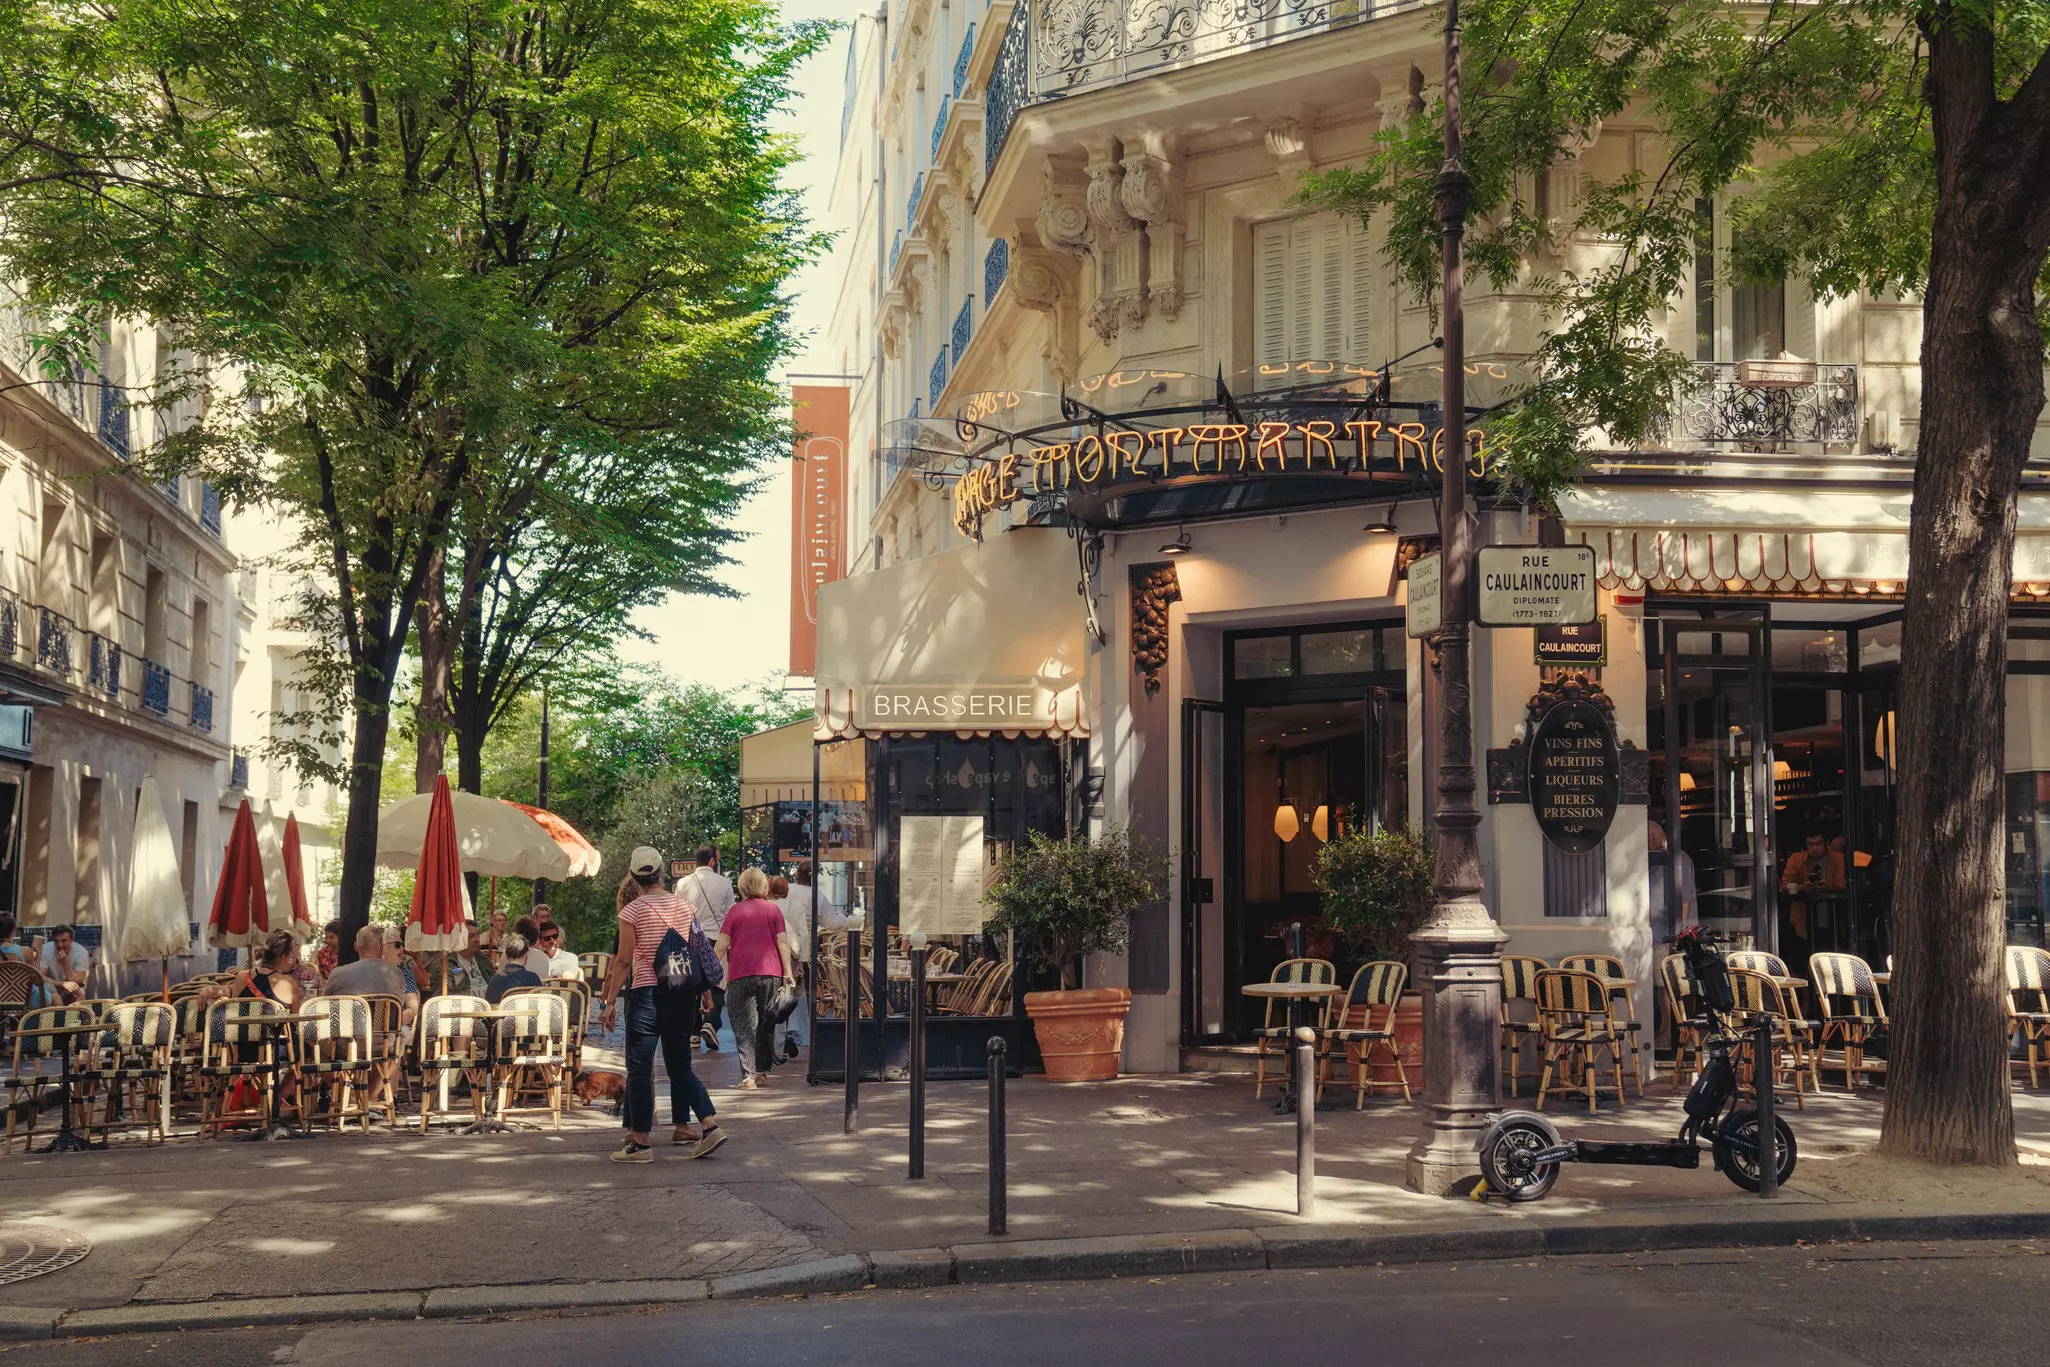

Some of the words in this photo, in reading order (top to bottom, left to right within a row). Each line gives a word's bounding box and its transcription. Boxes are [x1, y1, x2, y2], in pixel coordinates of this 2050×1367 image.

[1522, 556, 1550, 567] RUE
[1486, 573, 1586, 591] CAULAINCOURT
[1513, 596, 1560, 605] DIPLOMATE
[1562, 626, 1579, 635] RUE
[1539, 642, 1602, 653] CAULAINCOURT
[874, 694, 1032, 716] BRASSERIE
[1544, 738, 1572, 749] VINS
[1576, 738, 1603, 749] FINS
[1544, 756, 1604, 767] APERITIFS
[1545, 775, 1604, 788] LIQUEURS
[1553, 794, 1595, 805] BIERES
[1543, 807, 1604, 818] PRESSION
[677, 863, 693, 871] HO
